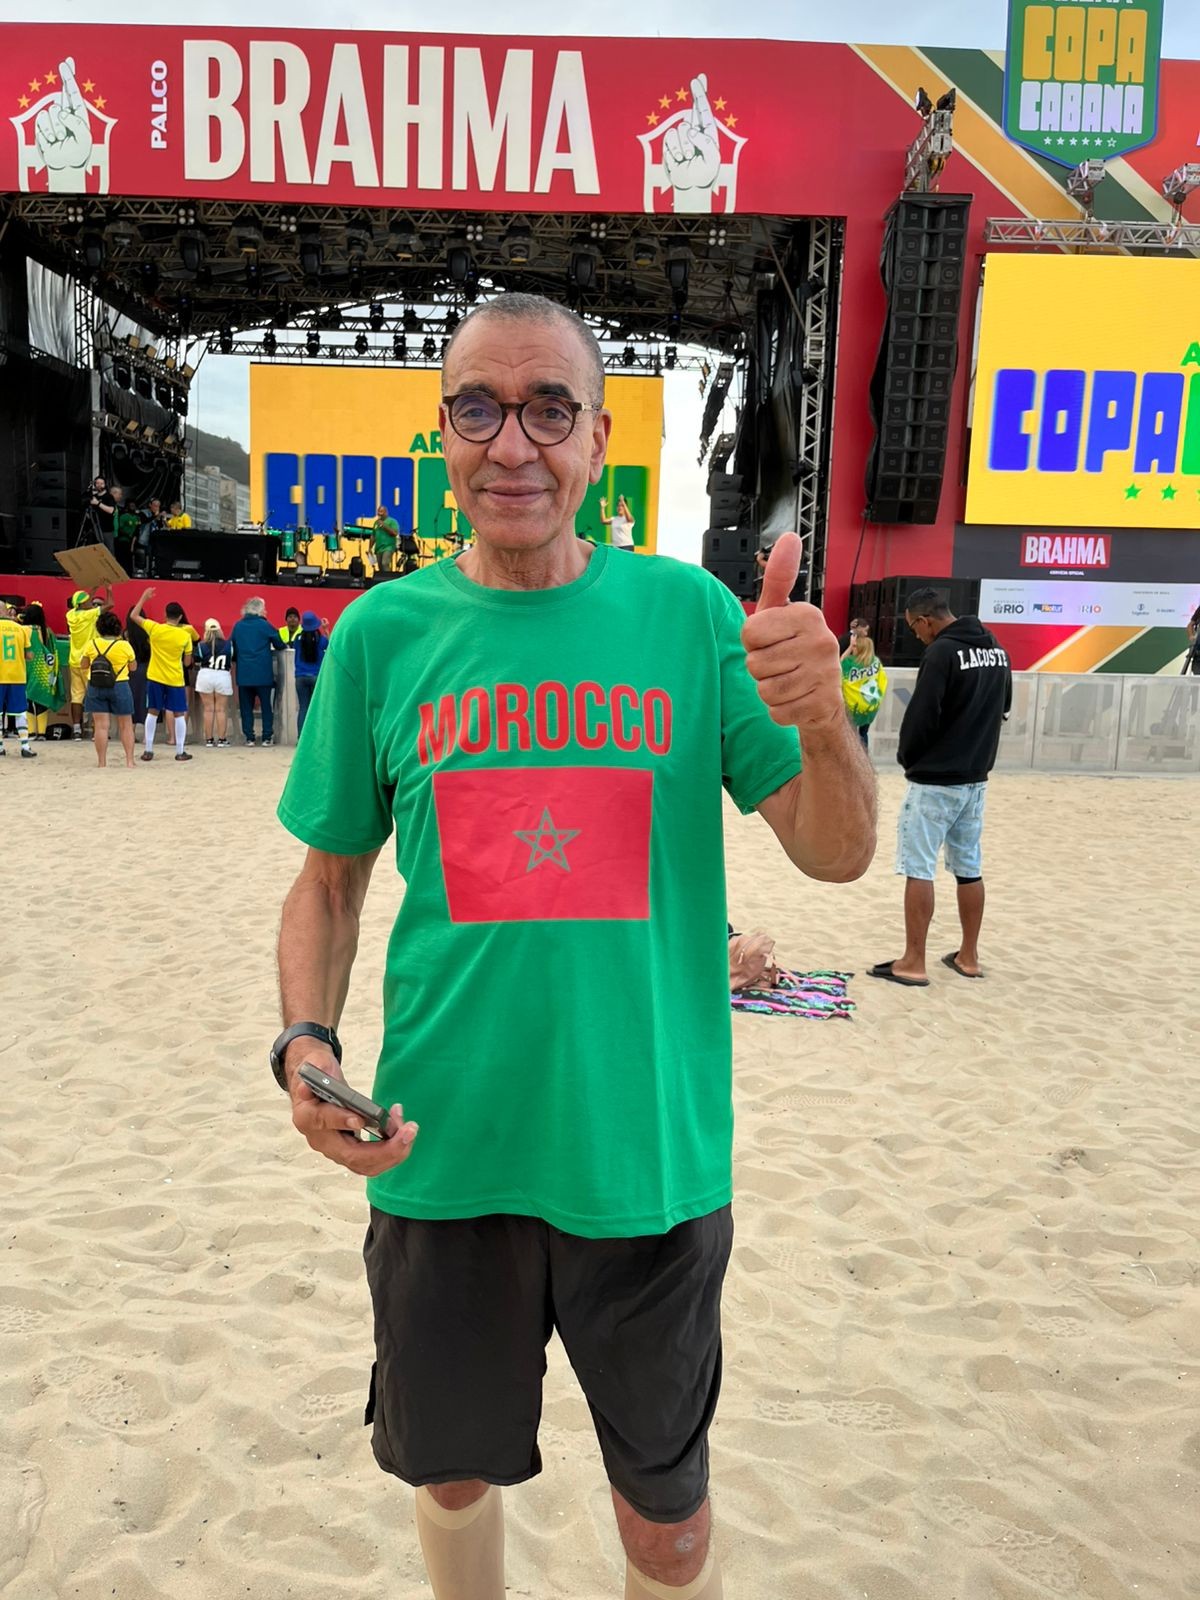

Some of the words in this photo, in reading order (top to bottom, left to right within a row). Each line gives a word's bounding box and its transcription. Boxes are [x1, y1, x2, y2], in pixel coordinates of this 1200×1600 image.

[1022, 5, 1148, 83] COPA
[151, 59, 168, 149] PALCO
[182, 39, 600, 195] BRAHMA
[1019, 81, 1144, 134] CABANA
[1024, 536, 1106, 565] BRAHMA
[1003, 604, 1024, 614] RIO
[3, 634, 16, 661] 6
[416, 679, 674, 767] MOROCCO
